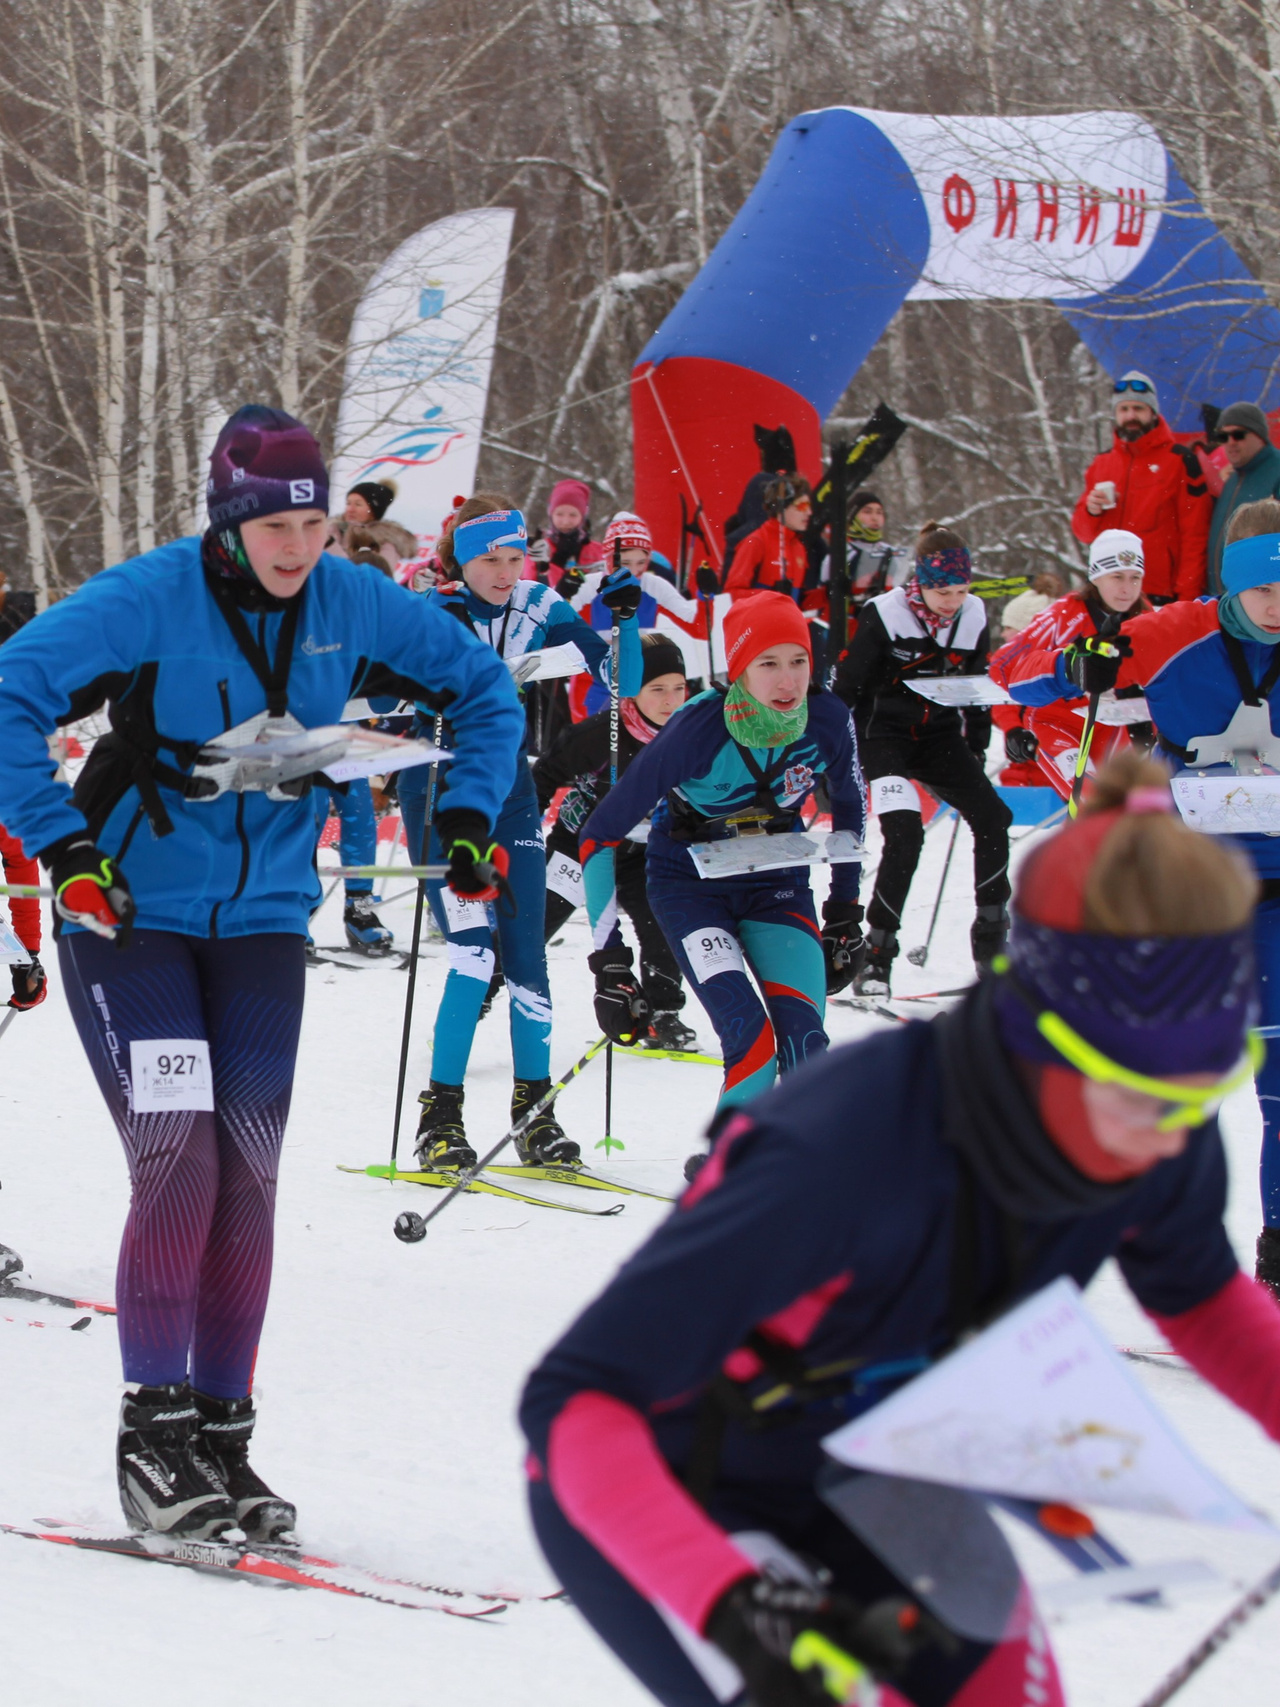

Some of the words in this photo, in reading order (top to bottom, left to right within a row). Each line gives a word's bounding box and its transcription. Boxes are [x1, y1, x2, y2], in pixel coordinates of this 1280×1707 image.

[943, 173, 1145, 247] ФИНИШ
[610, 680, 619, 752] NORDWAY
[881, 784, 904, 796] 942
[558, 863, 582, 884] 943
[701, 936, 733, 952] 915
[157, 1054, 197, 1076] 927
[544, 1170, 578, 1182] FISCHER
[125, 1452, 175, 1498] MADSHUS
